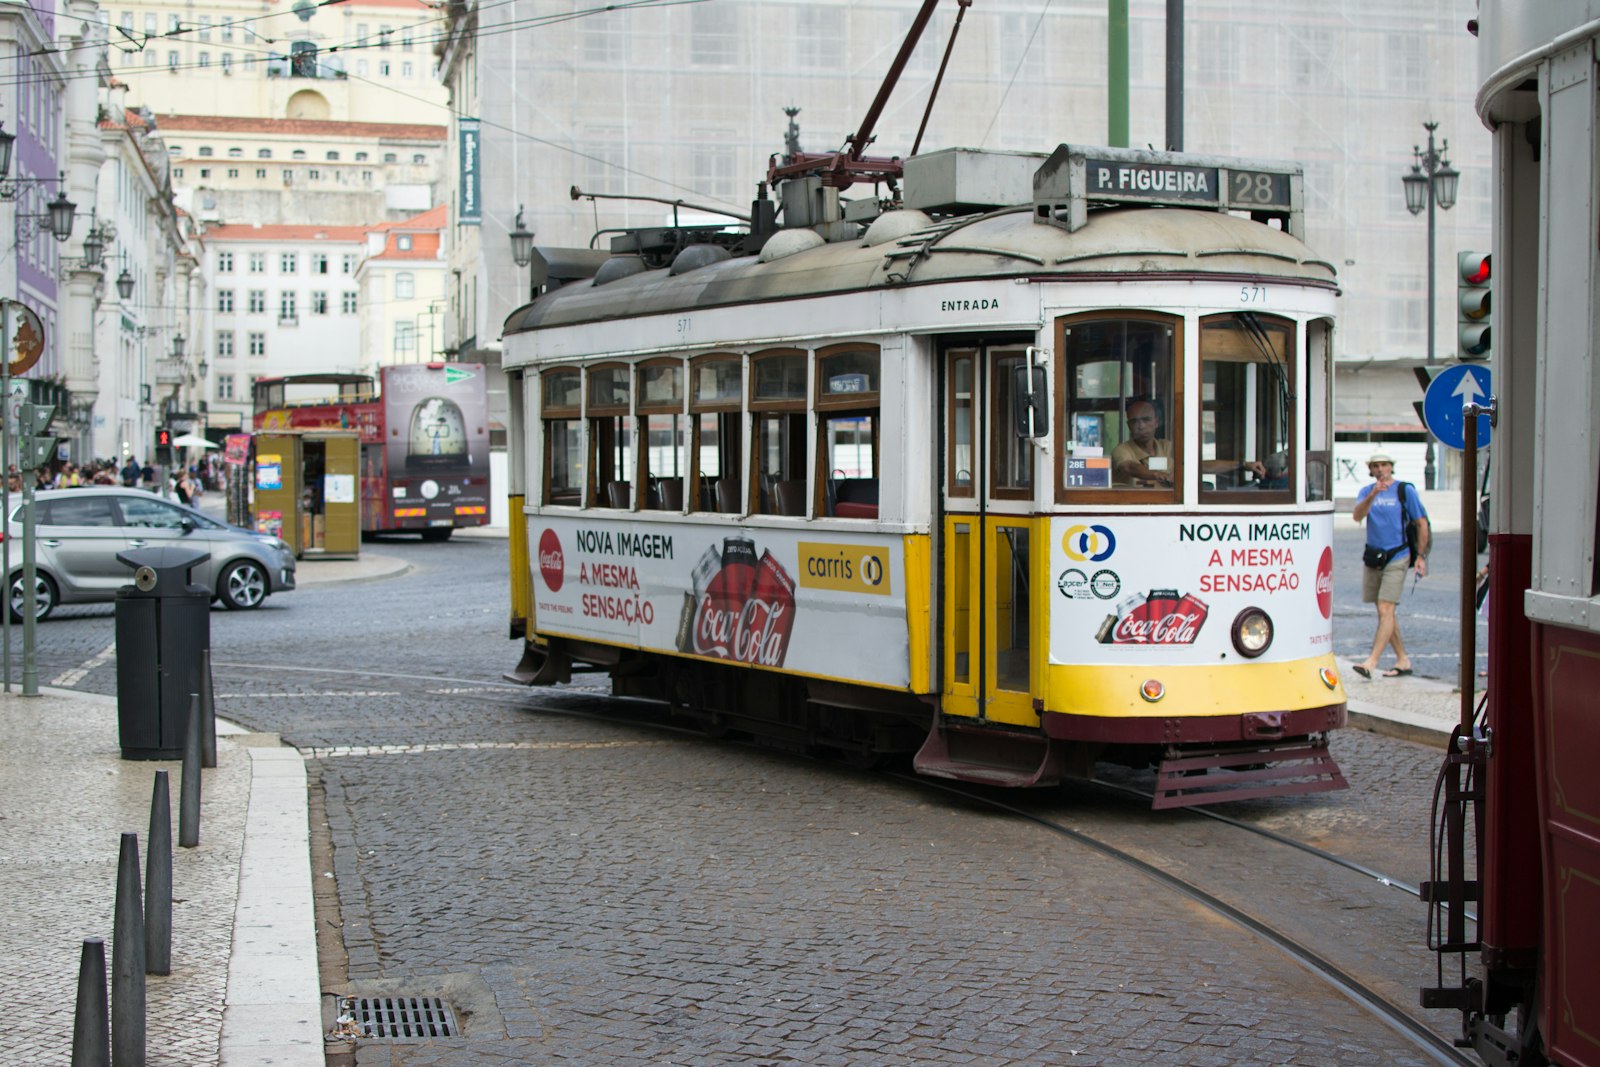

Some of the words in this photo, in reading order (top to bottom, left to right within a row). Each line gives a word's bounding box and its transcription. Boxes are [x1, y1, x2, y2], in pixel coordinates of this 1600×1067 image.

[1098, 168, 1113, 189] P.
[1119, 168, 1209, 193] FIGUEIRA
[1235, 172, 1273, 204] 28
[941, 299, 999, 312] ENTRADA
[1240, 286, 1267, 303] 571
[677, 318, 692, 333] 571
[1068, 460, 1085, 469] 28E
[1069, 474, 1083, 486] 11
[576, 529, 614, 556] NOVA
[617, 532, 674, 561] IMAGEM
[1179, 523, 1241, 542] NOVA
[1248, 522, 1310, 541] IMAGEM
[807, 550, 853, 580] carris
[1208, 548, 1223, 567] A
[1230, 547, 1294, 567] MESMA
[580, 561, 590, 585] A
[591, 562, 641, 591] MESMA
[1199, 567, 1300, 595] SENSAÇÃO
[582, 593, 655, 627] SENSAÇÃO
[692, 592, 786, 666] Coca-Cola
[1112, 612, 1200, 643] Coca-Cola
